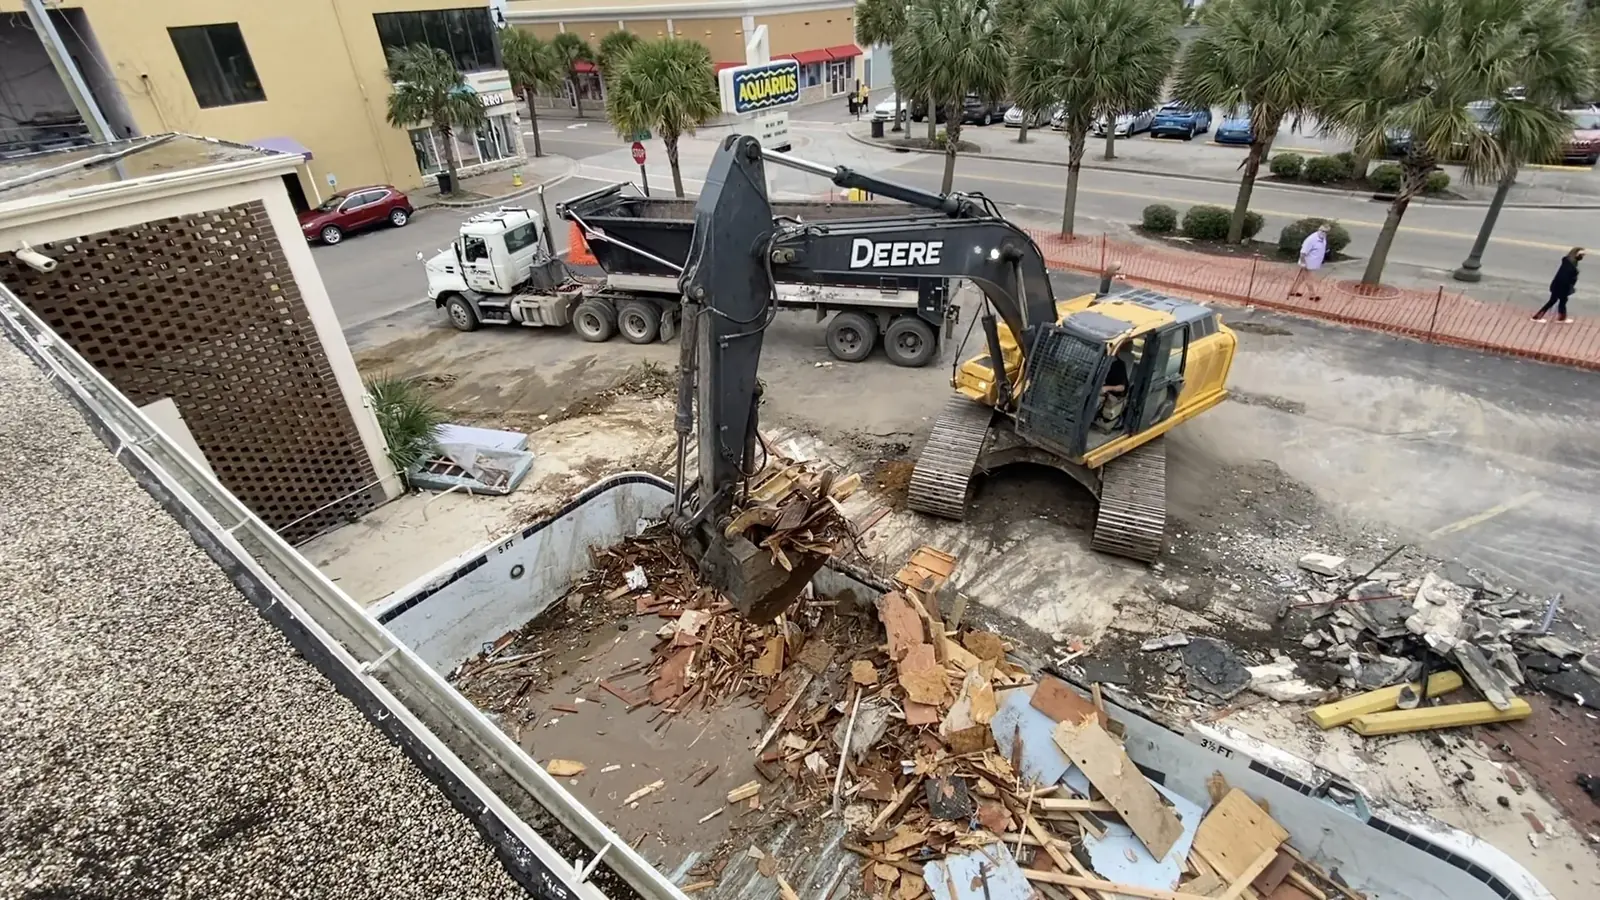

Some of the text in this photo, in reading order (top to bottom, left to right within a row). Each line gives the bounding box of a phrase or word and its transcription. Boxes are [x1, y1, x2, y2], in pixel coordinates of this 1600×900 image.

[739, 74, 797, 102] AQUARIUS
[632, 148, 645, 158] STOP
[850, 238, 943, 268] DEERE
[498, 539, 514, 554] 5 FT
[1217, 745, 1234, 758] FT
